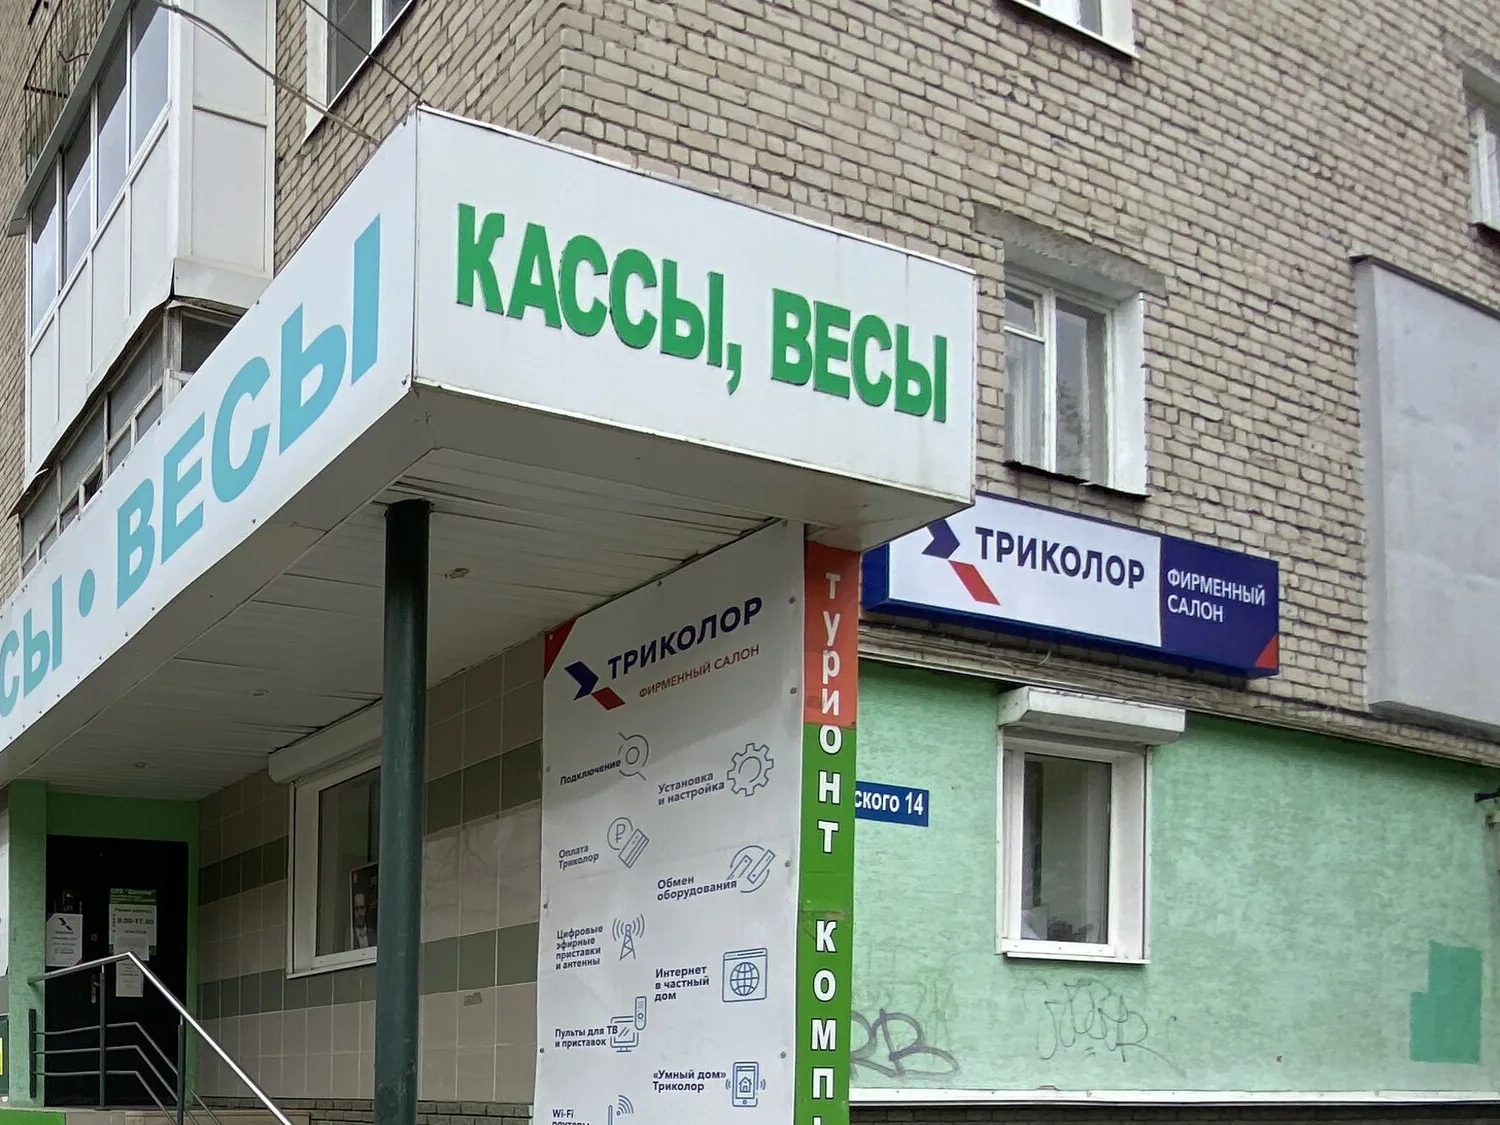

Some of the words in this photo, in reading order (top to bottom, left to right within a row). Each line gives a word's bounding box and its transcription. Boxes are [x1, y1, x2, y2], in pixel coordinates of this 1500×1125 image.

[456, 202, 742, 395] КАССЫ,
[771, 288, 947, 422] ВЕСЫ
[116, 213, 381, 608] ВЕСЫ
[975, 527, 1145, 589] ТРИКОЛОР
[1167, 568, 1266, 607] ФИРМЕННЫЙ
[1167, 595, 1224, 623] САЛОН
[607, 597, 763, 680] ТРИКОЛОР
[639, 658, 711, 698] ФИРМЕННЫЙ
[714, 644, 760, 673] САЛОН
[560, 759, 621, 786] Подключение
[658, 773, 714, 794] Установка
[658, 797, 665, 806] и
[667, 781, 725, 804] настройка
[905, 792, 924, 815] 14
[558, 845, 589, 859] Оплата
[558, 853, 600, 870] Триколор
[657, 876, 695, 890] Обмен
[657, 880, 738, 901] оборудования
[556, 925, 603, 940] Цифровые
[556, 936, 595, 951] эфирные
[555, 947, 601, 961] приставки
[555, 962, 561, 970] и
[562, 958, 600, 969] антенны
[655, 966, 707, 979] Интернет
[655, 982, 661, 990] в
[664, 975, 710, 989] частный
[654, 991, 677, 1002] дом
[555, 1028, 586, 1039] Пульты
[587, 1029, 604, 1037] для
[607, 1026, 618, 1035] ТВ
[562, 1038, 607, 1049] приставок
[653, 1069, 695, 1080] «Умный
[697, 1072, 726, 1081] дом»
[653, 1081, 705, 1093] Триколор
[552, 1109, 574, 1118] Wi-Fi
